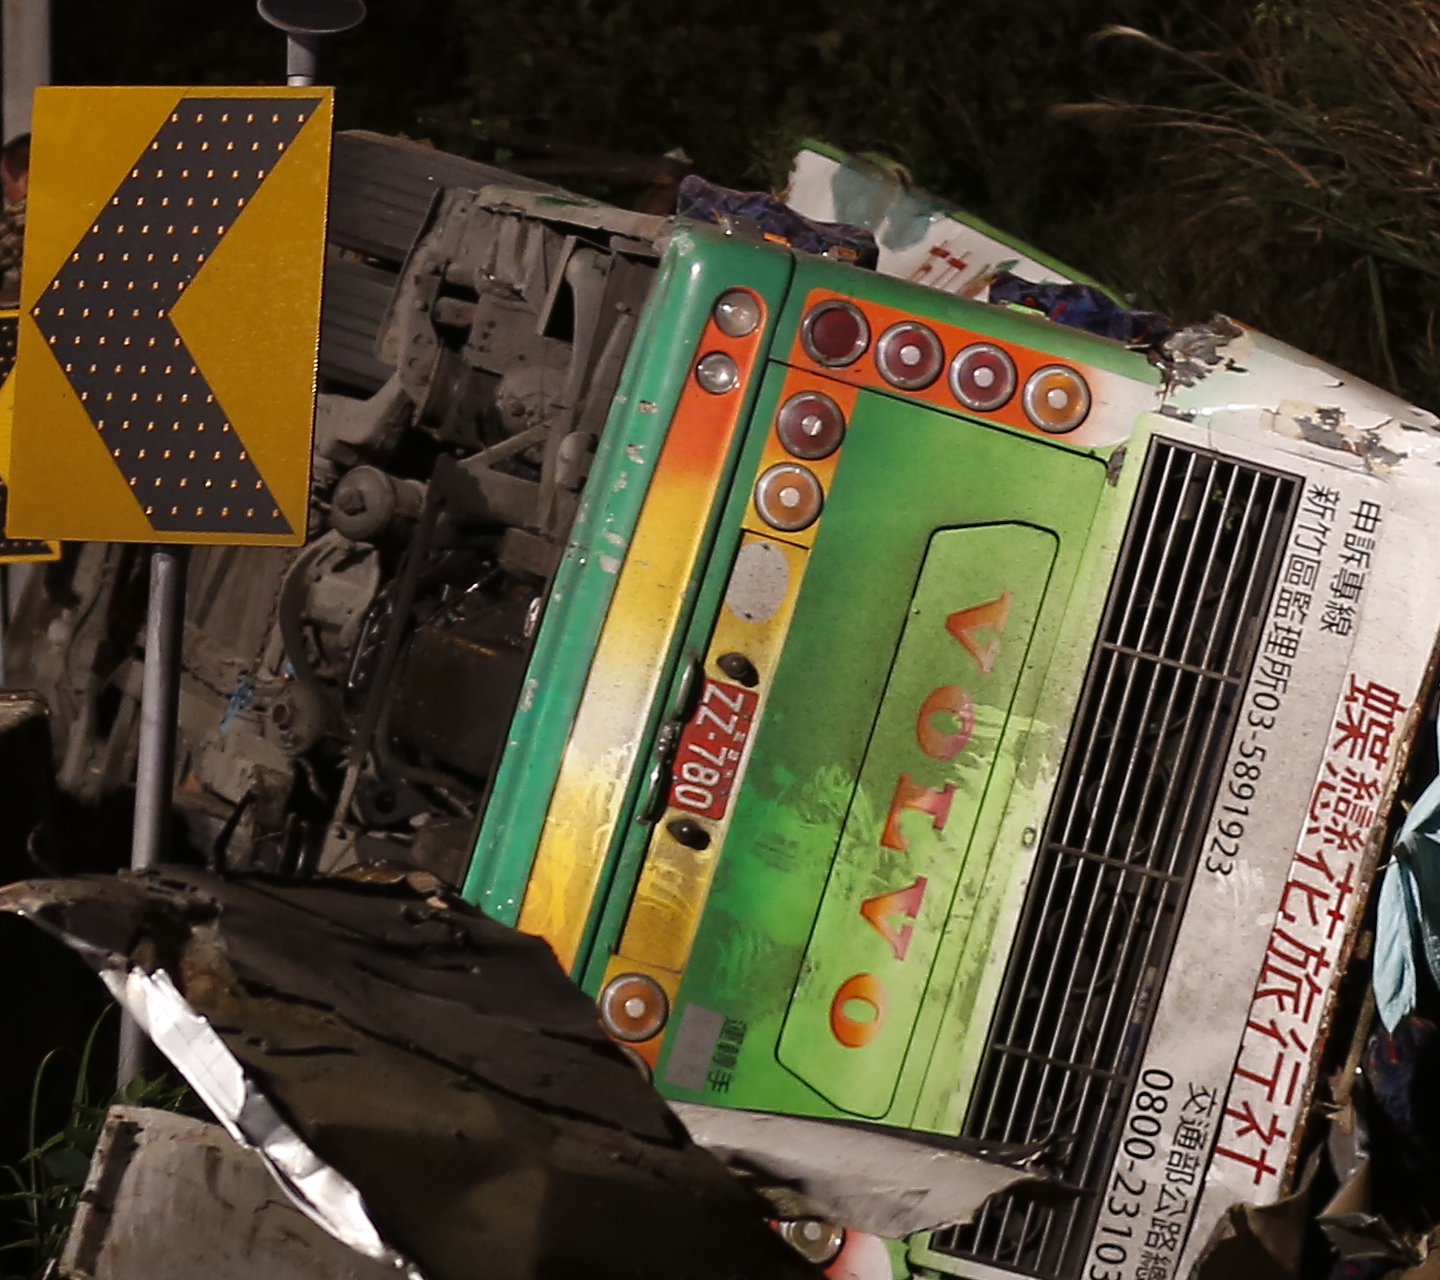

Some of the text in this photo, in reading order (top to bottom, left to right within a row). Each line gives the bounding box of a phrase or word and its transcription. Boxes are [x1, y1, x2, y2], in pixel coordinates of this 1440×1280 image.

[676, 685, 743, 809] ZZ-780
[1204, 486, 1339, 877] 新竹區監理所03-5891923
[1321, 501, 1381, 636] 申訴專線
[831, 593, 1012, 1048] VOLVO
[1217, 673, 1406, 1183] 蝶戀花旅行社
